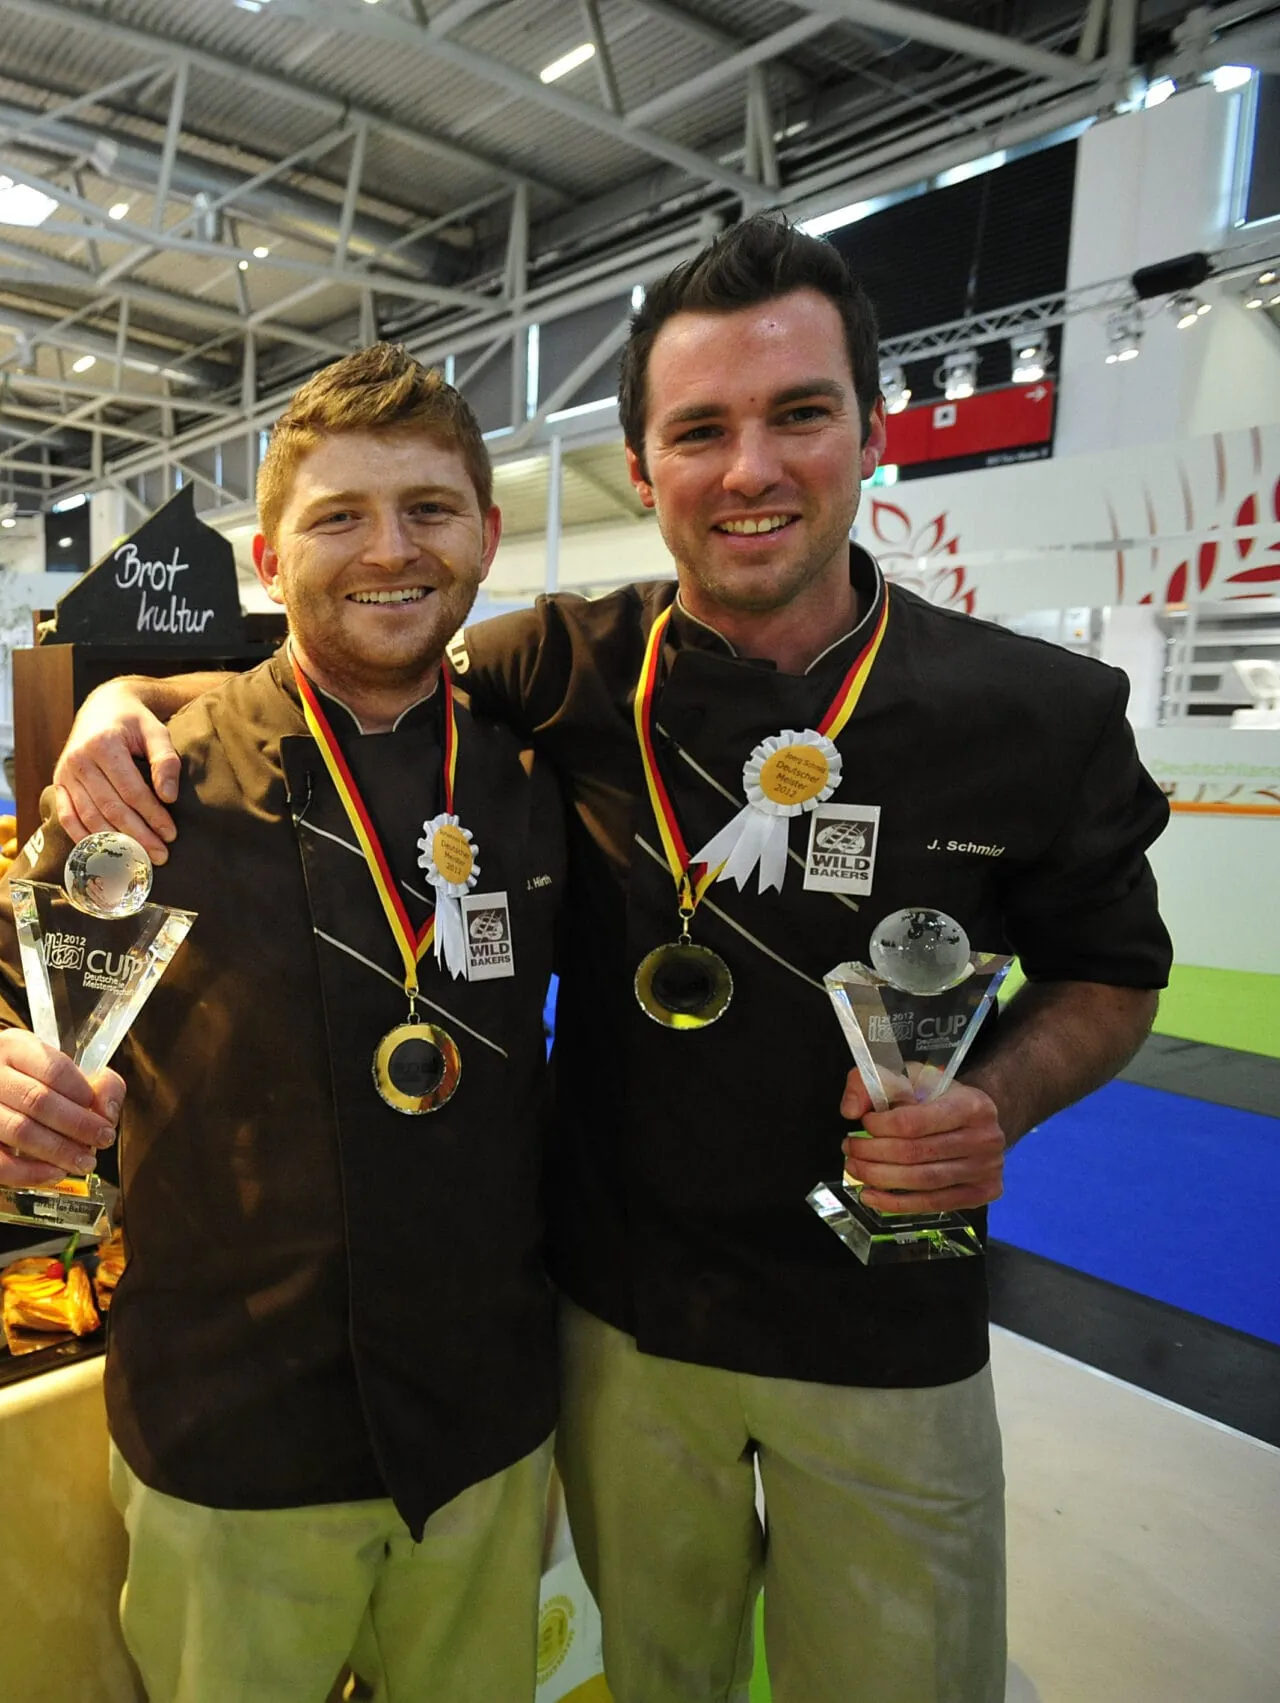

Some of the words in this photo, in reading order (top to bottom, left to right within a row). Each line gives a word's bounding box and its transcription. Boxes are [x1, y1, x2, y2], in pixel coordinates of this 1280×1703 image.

[114, 543, 189, 592] Brot
[137, 591, 214, 633] kultur
[775, 760, 820, 783] Deutscher
[775, 772, 808, 790] Meister
[773, 783, 797, 798] 2012
[927, 840, 941, 850] J.
[946, 840, 1005, 857] Schmid
[812, 854, 871, 871] WILD
[809, 867, 869, 881] BAKERS
[65, 934, 87, 946] 2012
[469, 942, 510, 958] WILD
[470, 954, 511, 967] BAKERS
[892, 1011, 914, 1021] 2012
[917, 1014, 967, 1037] CUP
